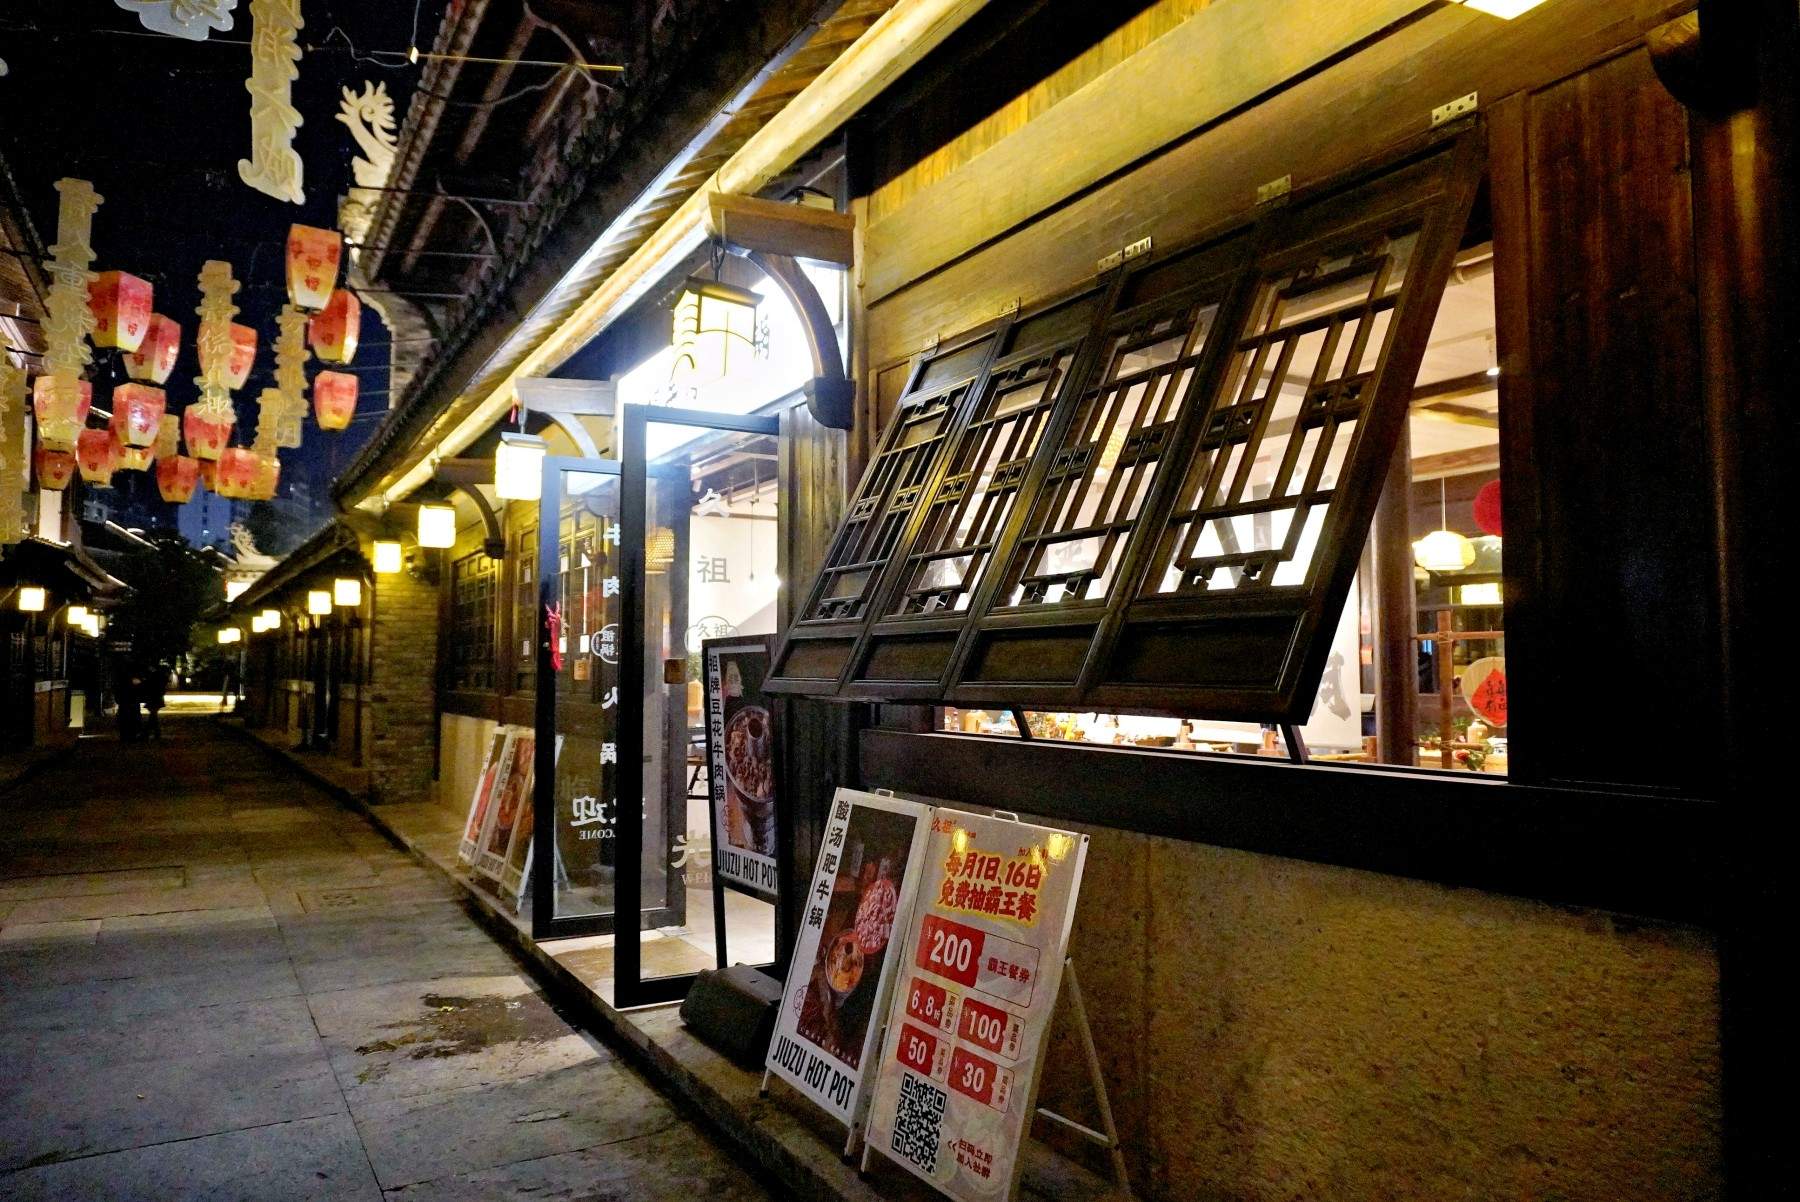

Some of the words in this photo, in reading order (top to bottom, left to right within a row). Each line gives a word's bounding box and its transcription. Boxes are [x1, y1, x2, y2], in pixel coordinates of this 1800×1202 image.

[718, 848, 741, 877] JIUZU
[743, 856, 760, 883] HOT
[762, 862, 778, 890] POT
[808, 800, 850, 930] 酸汤肥牛锅
[938, 877, 1037, 922] 免费抽霸王餐
[772, 1035, 808, 1077] JIUZU
[803, 1054, 832, 1094] HOT
[827, 1070, 856, 1111] POT
